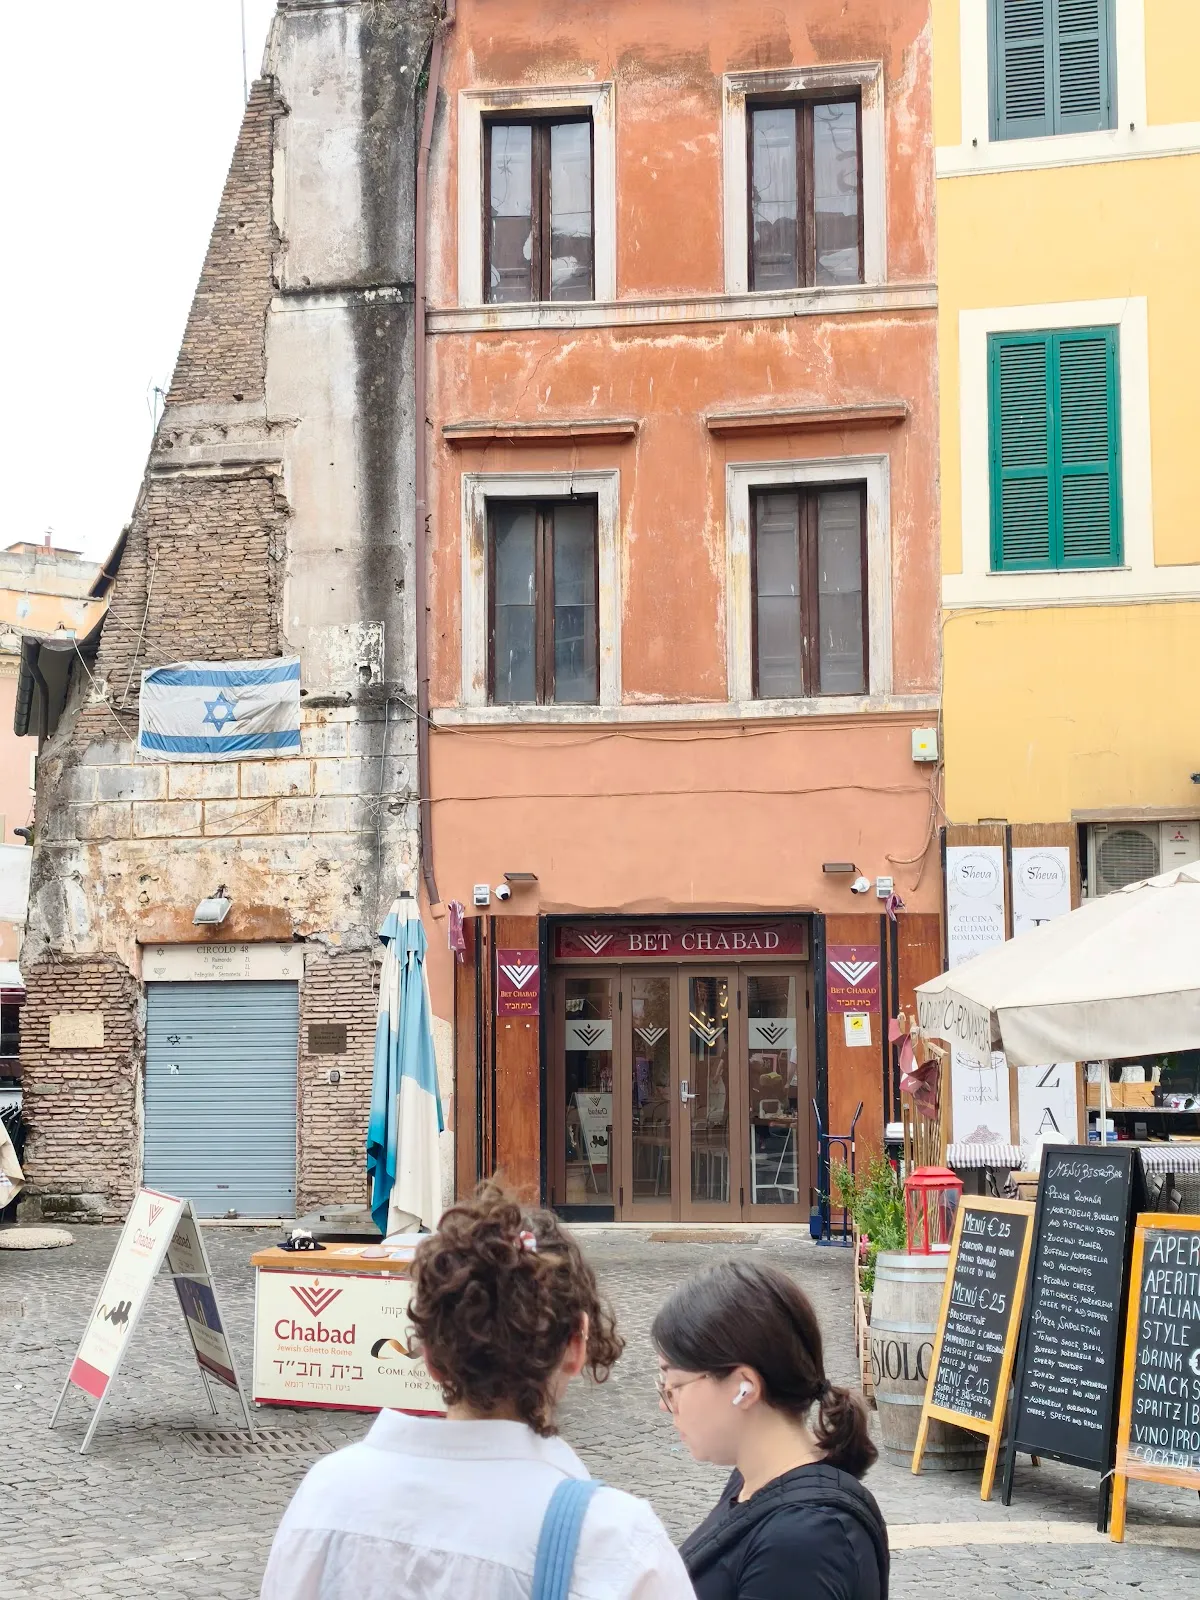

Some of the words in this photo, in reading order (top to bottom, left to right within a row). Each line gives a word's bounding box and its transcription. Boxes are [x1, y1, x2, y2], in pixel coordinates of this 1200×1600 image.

[961, 866, 991, 879] Sheva
[1027, 866, 1058, 880] Sheva
[628, 933, 672, 951] BET
[681, 931, 779, 950] CHABAD
[274, 1319, 356, 1344] Chabad
[1143, 1320, 1191, 1346] STYLE
[277, 1344, 301, 1352] Jewish
[303, 1346, 329, 1355] Ghetto
[331, 1348, 352, 1356] Rome
[1142, 1345, 1182, 1372] DRINK
[330, 1364, 363, 1380] בית
[424, 1382, 430, 1390] 2
